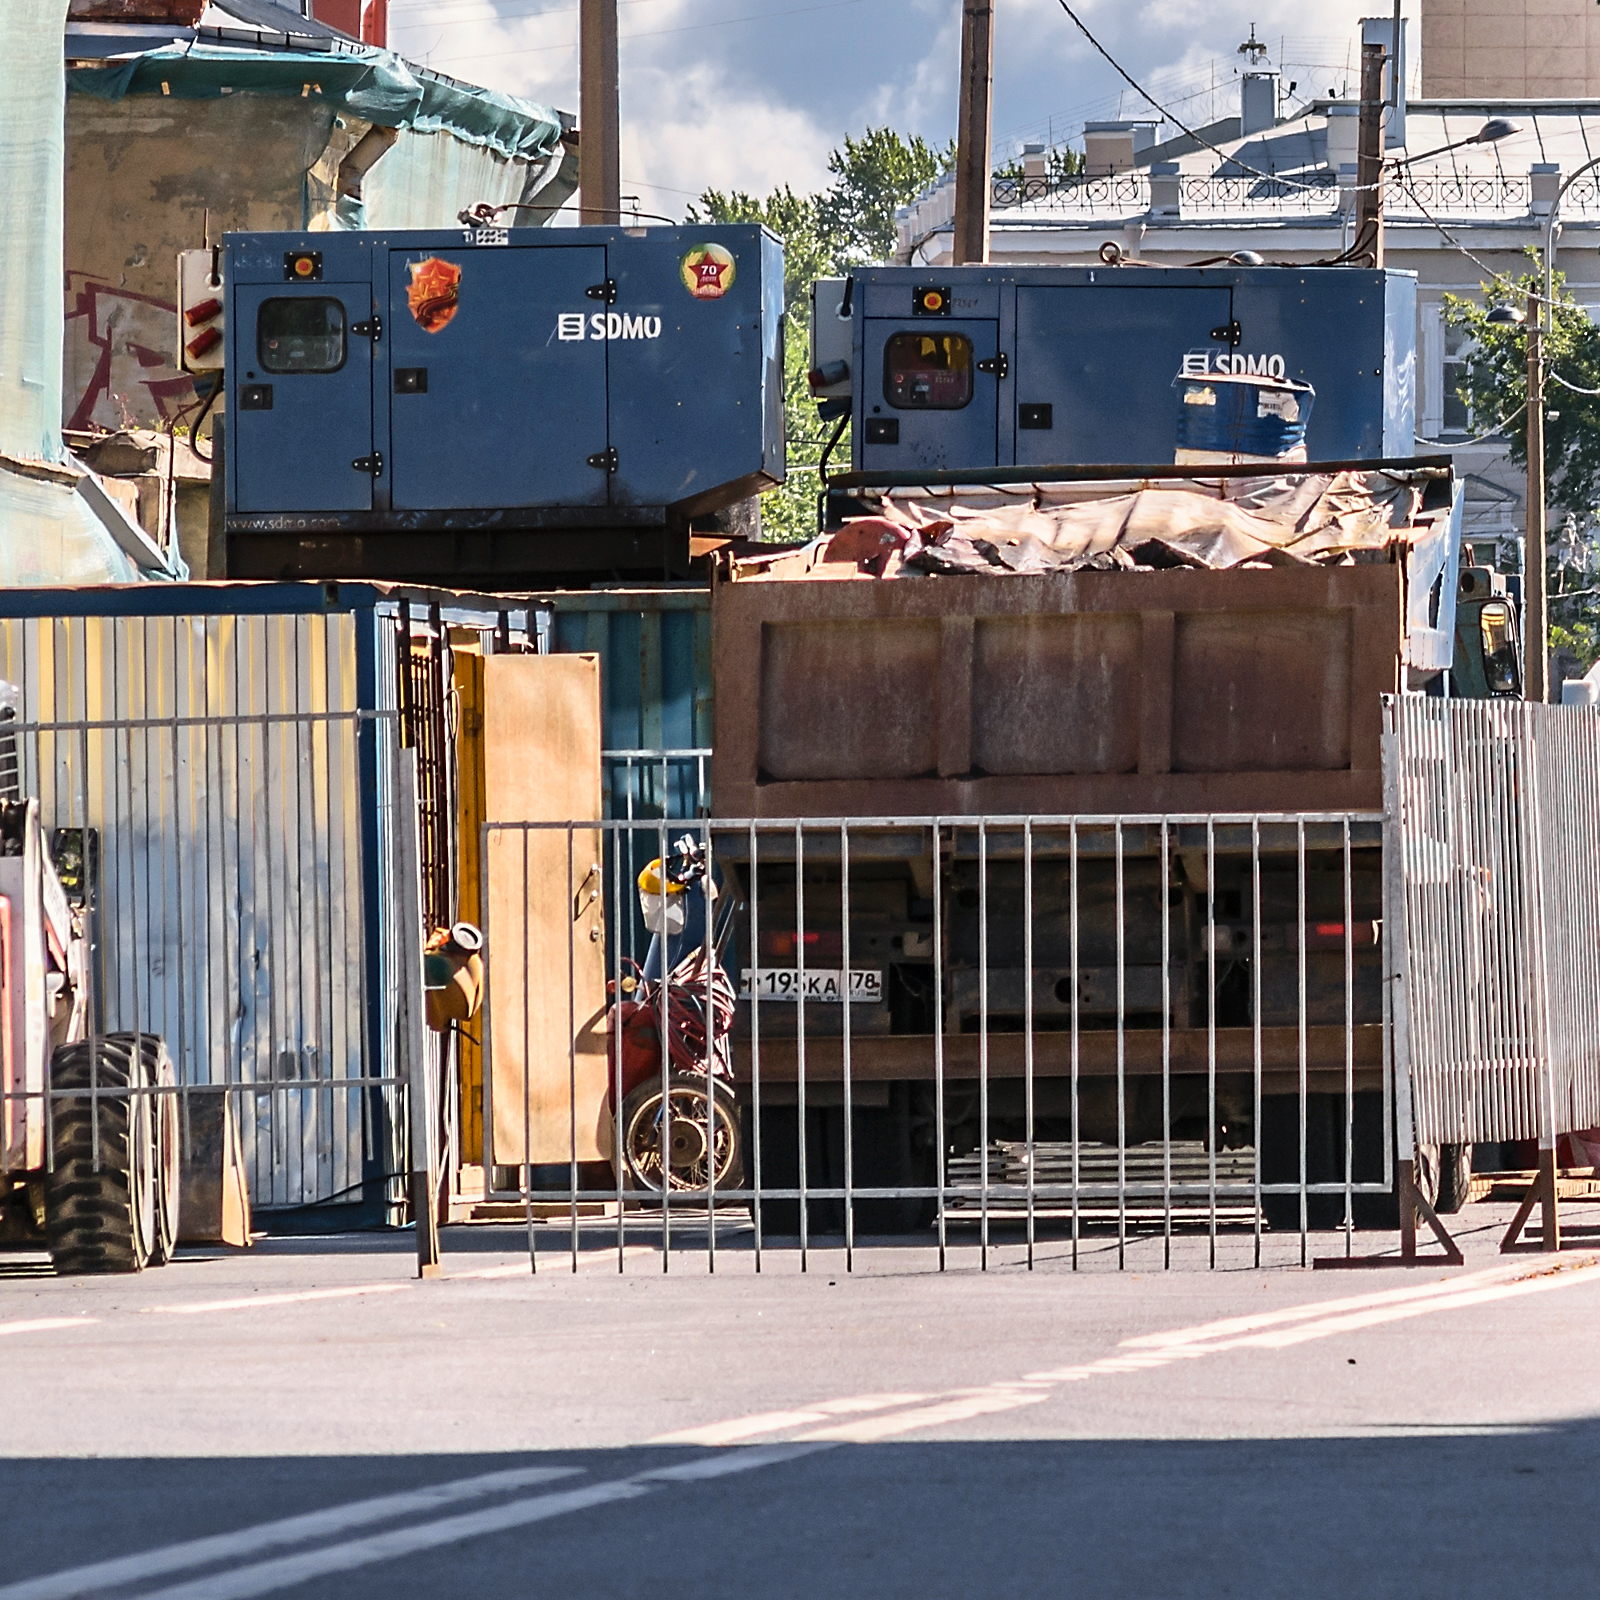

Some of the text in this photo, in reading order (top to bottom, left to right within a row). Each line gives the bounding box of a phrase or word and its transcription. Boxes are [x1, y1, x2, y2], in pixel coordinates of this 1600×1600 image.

[701, 265, 717, 276] 70
[590, 312, 661, 340] SDMO
[1215, 353, 1285, 379] SDMO
